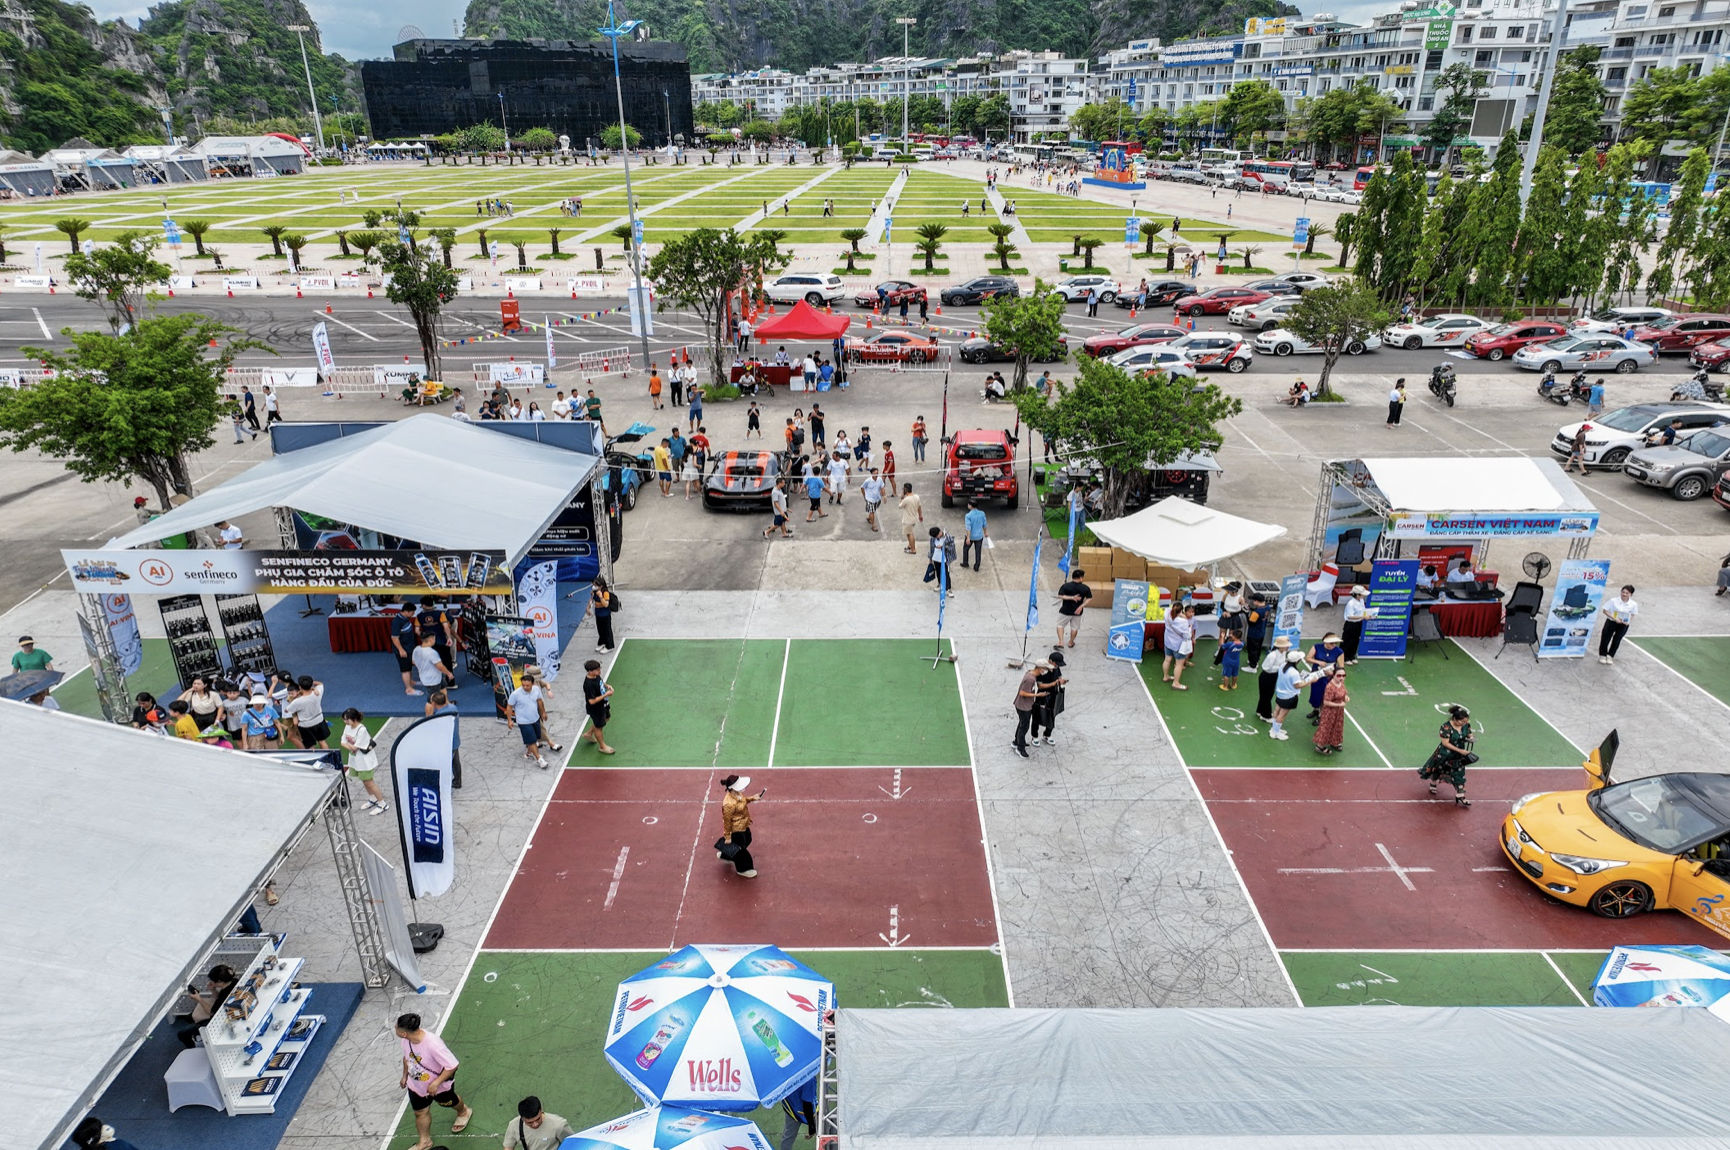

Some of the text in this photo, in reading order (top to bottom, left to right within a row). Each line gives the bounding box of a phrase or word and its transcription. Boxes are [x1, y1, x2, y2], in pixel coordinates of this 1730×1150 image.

[1431, 518, 1555, 530] CARSEN VIỆT NAM
[150, 566, 165, 576] AI
[185, 568, 237, 580] senfineco
[255, 569, 281, 577] PHỤ
[308, 568, 344, 576] CHĂM
[347, 567, 372, 576] SÓC
[375, 567, 385, 576] Ô
[387, 567, 404, 576] TÔ
[1582, 572, 1606, 580] 15%
[271, 577, 393, 587] HÀNG ĐẦU CỦA ĐỨC
[114, 594, 126, 606] AI
[534, 612, 546, 621] AI
[413, 787, 418, 796] We
[422, 788, 440, 844] AISIN
[612, 990, 630, 1036] PETROVIETNAM
[687, 1057, 741, 1092] Wells
